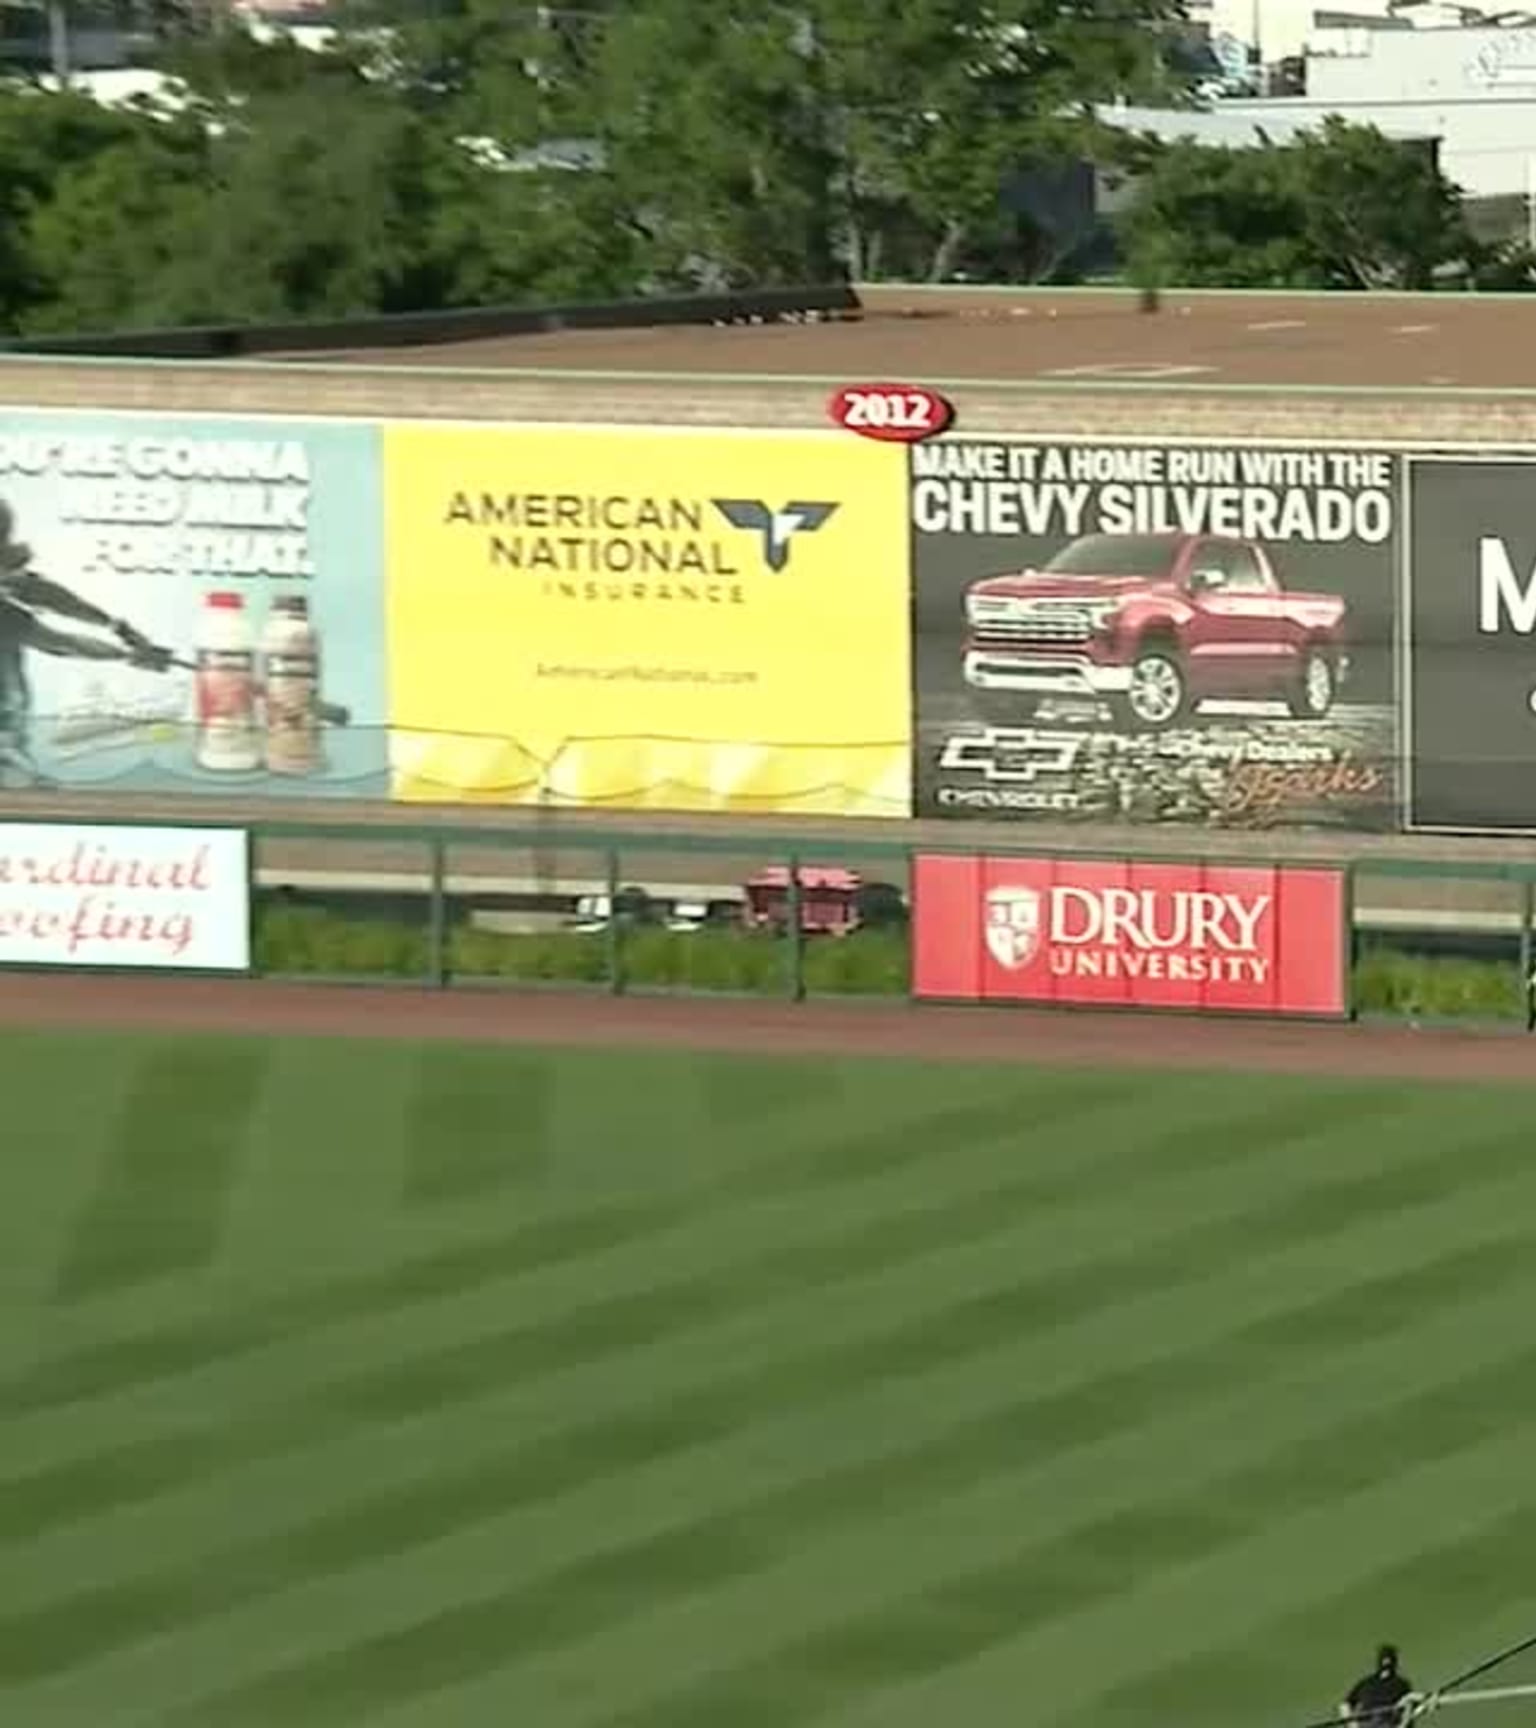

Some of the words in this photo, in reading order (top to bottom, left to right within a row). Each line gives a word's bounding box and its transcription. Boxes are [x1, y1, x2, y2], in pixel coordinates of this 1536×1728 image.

[843, 394, 932, 427] 2012
[914, 444, 1003, 478] MAKE
[1009, 446, 1039, 479] IT
[1043, 447, 1068, 480] A
[1072, 448, 1163, 483] HOME
[1168, 451, 1237, 485] RUN
[1239, 452, 1324, 487] WITH
[1329, 454, 1391, 487] THE
[185, 487, 307, 528] MILK
[444, 490, 702, 532] AMERICAN
[914, 481, 1094, 535] CHEVY
[1100, 485, 1391, 542] SILVERADO
[489, 536, 738, 575] NATIONAL
[544, 582, 745, 604] INSURANCE
[1050, 887, 1272, 951] DRURY
[1050, 949, 1269, 983] UNIVERSITY
